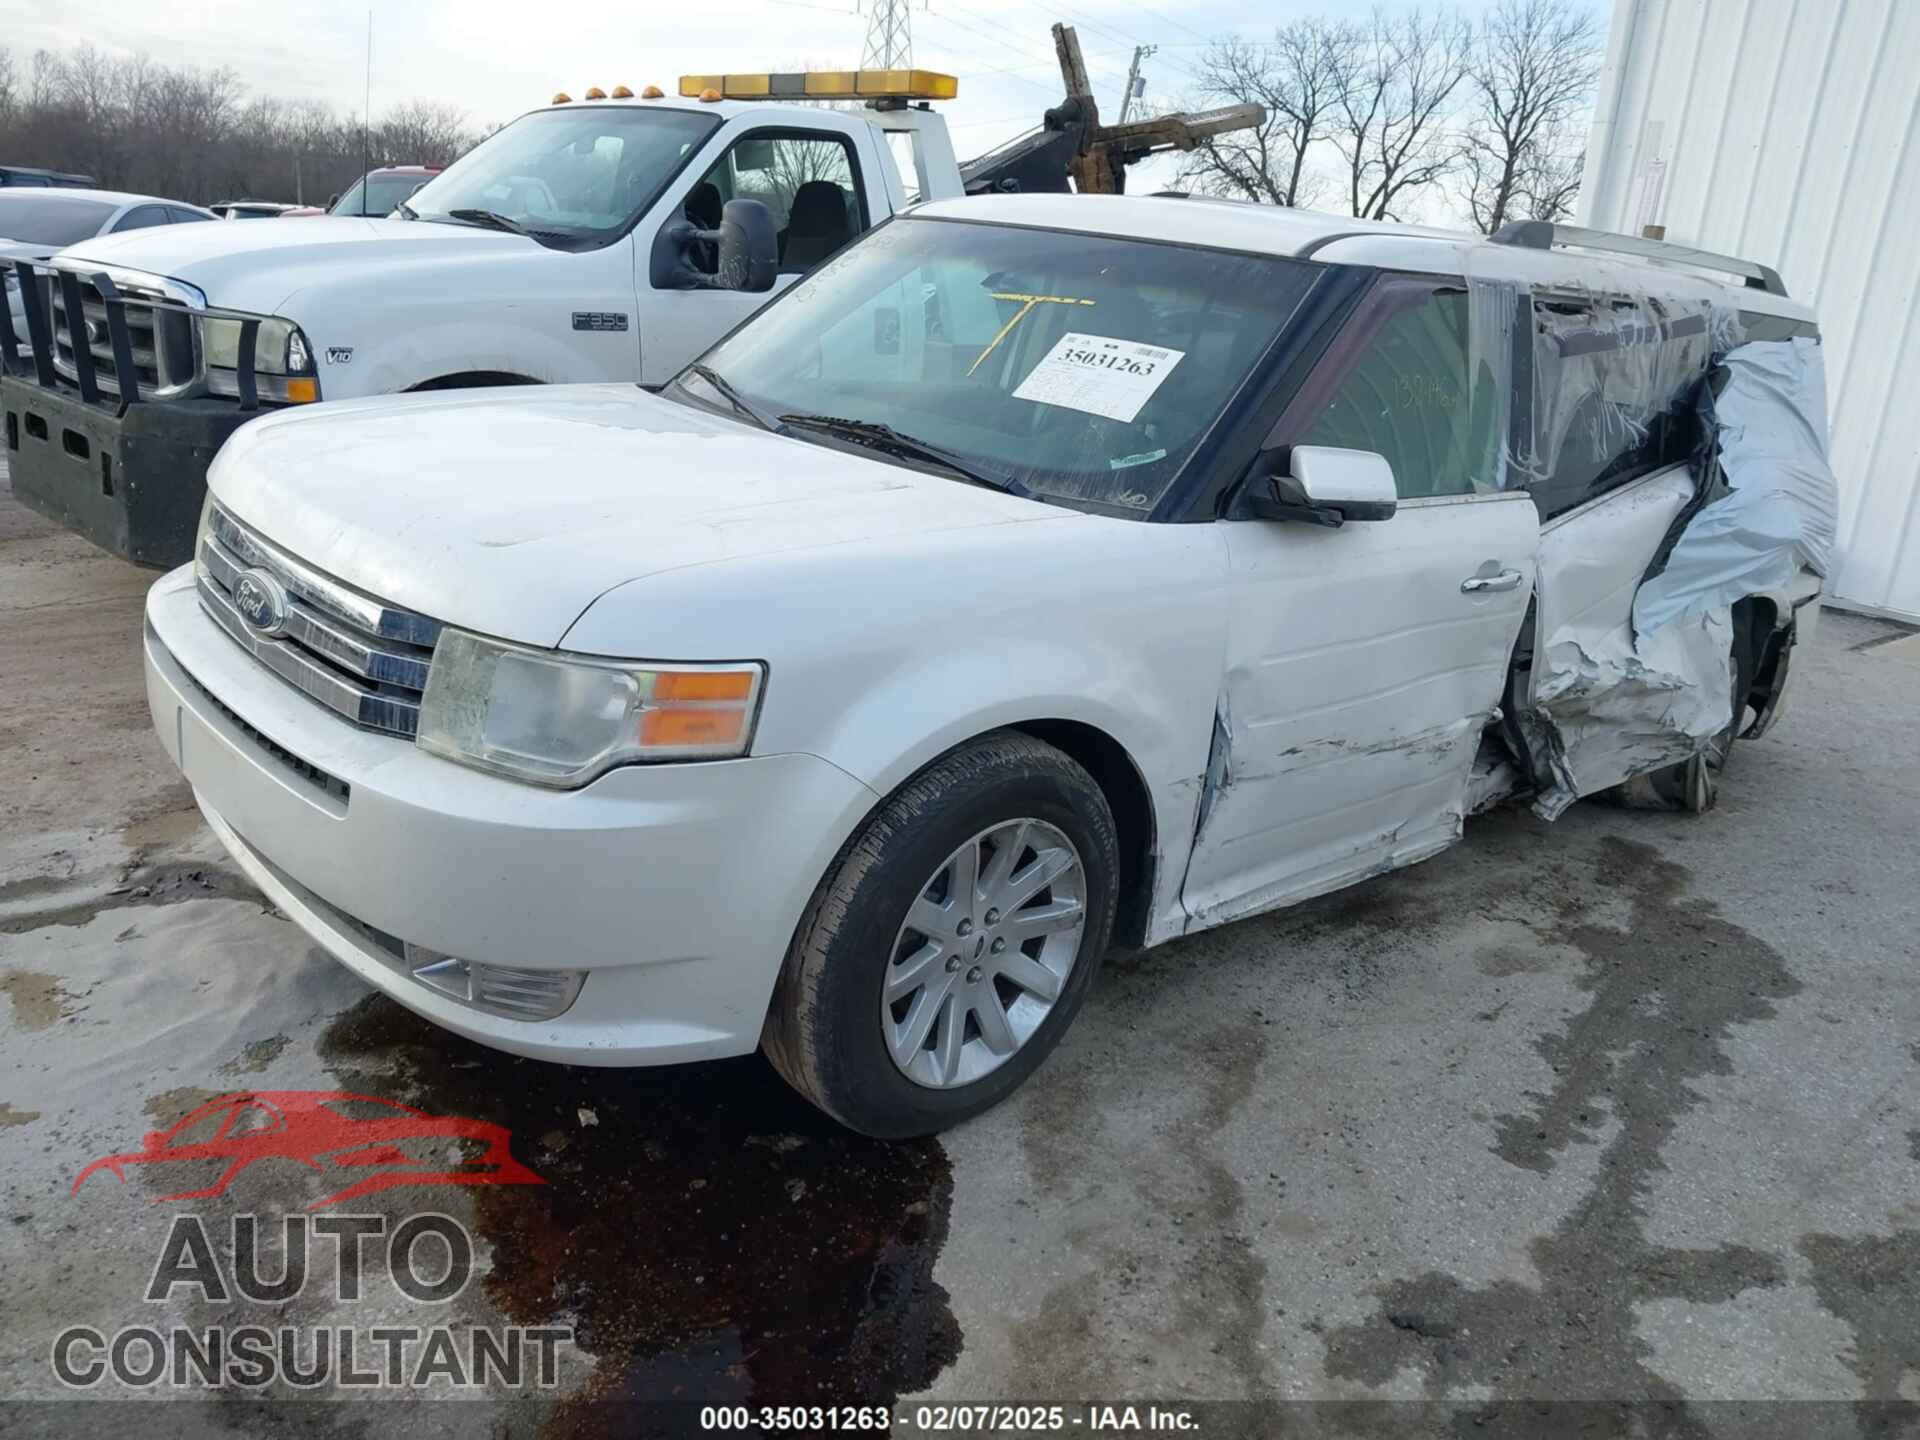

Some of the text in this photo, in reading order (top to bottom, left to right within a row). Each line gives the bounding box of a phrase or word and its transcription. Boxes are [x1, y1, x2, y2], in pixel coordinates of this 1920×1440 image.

[326, 351, 352, 364] V10
[1057, 348, 1156, 377] 35031263
[236, 579, 266, 619] Ford
